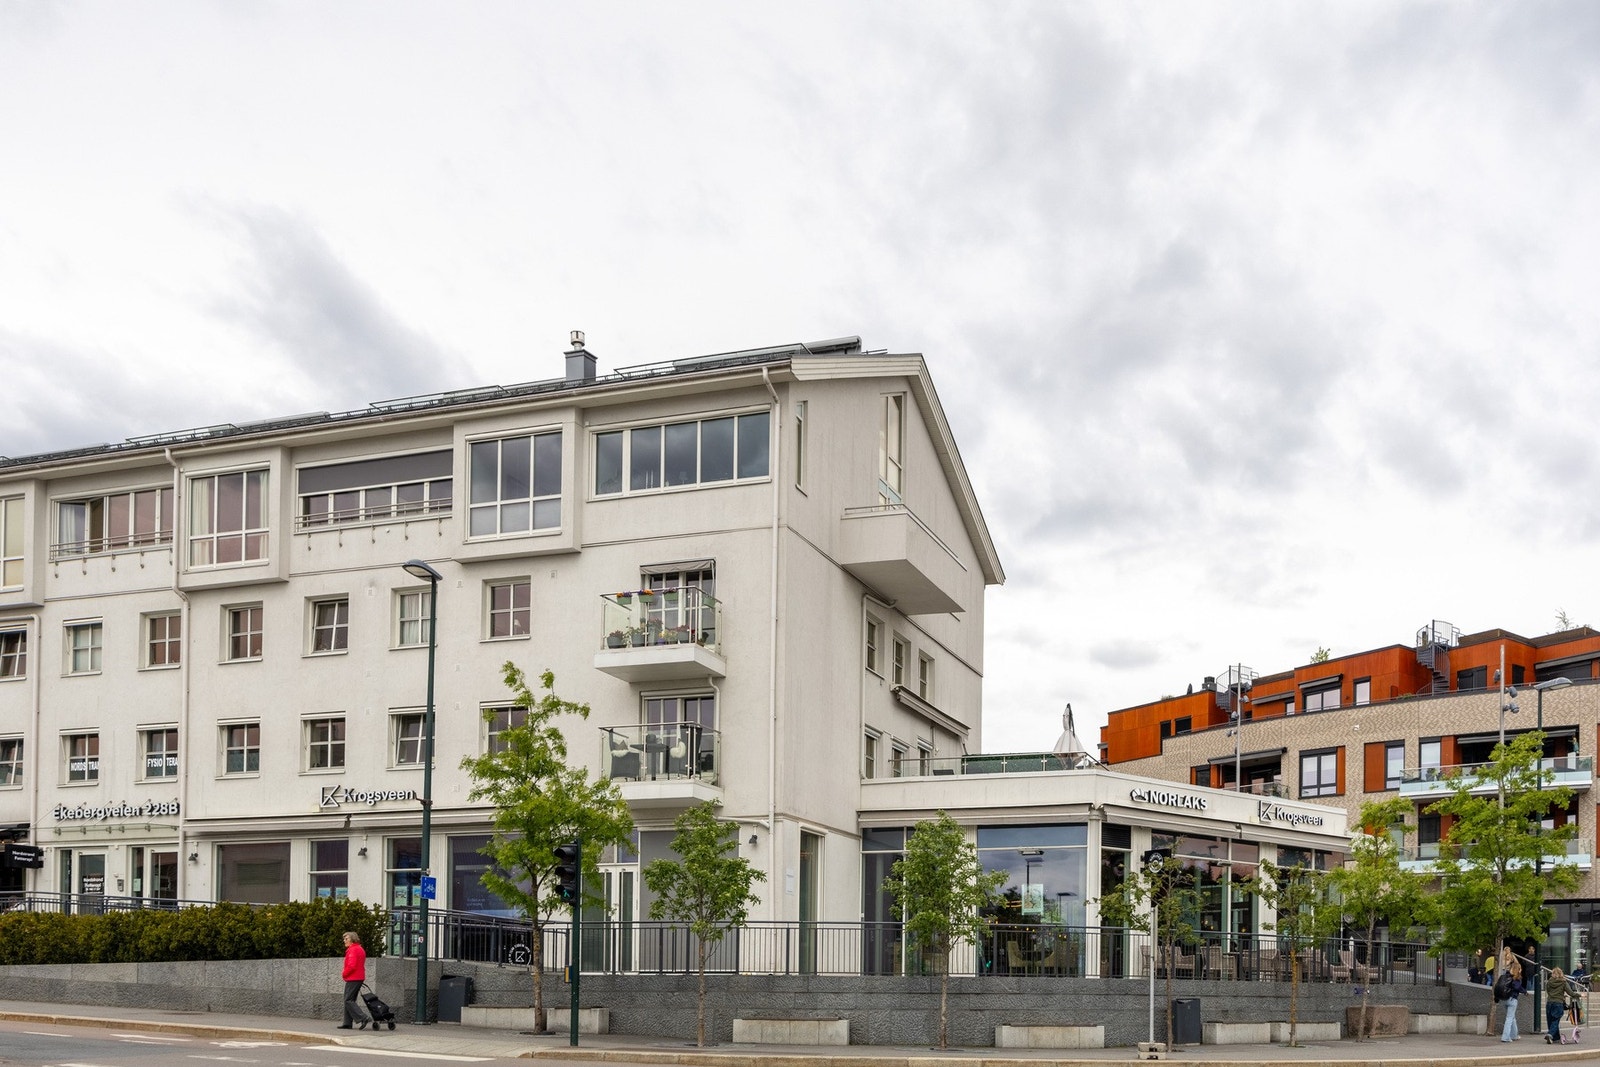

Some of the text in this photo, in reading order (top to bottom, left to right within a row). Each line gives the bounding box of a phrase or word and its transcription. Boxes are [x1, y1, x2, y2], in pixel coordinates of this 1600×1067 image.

[147, 758, 163, 768] FYSIO
[343, 788, 415, 806] Krogsveen
[1149, 790, 1208, 810] NORLAKS
[52, 802, 180, 820] Ekebergveien 228B
